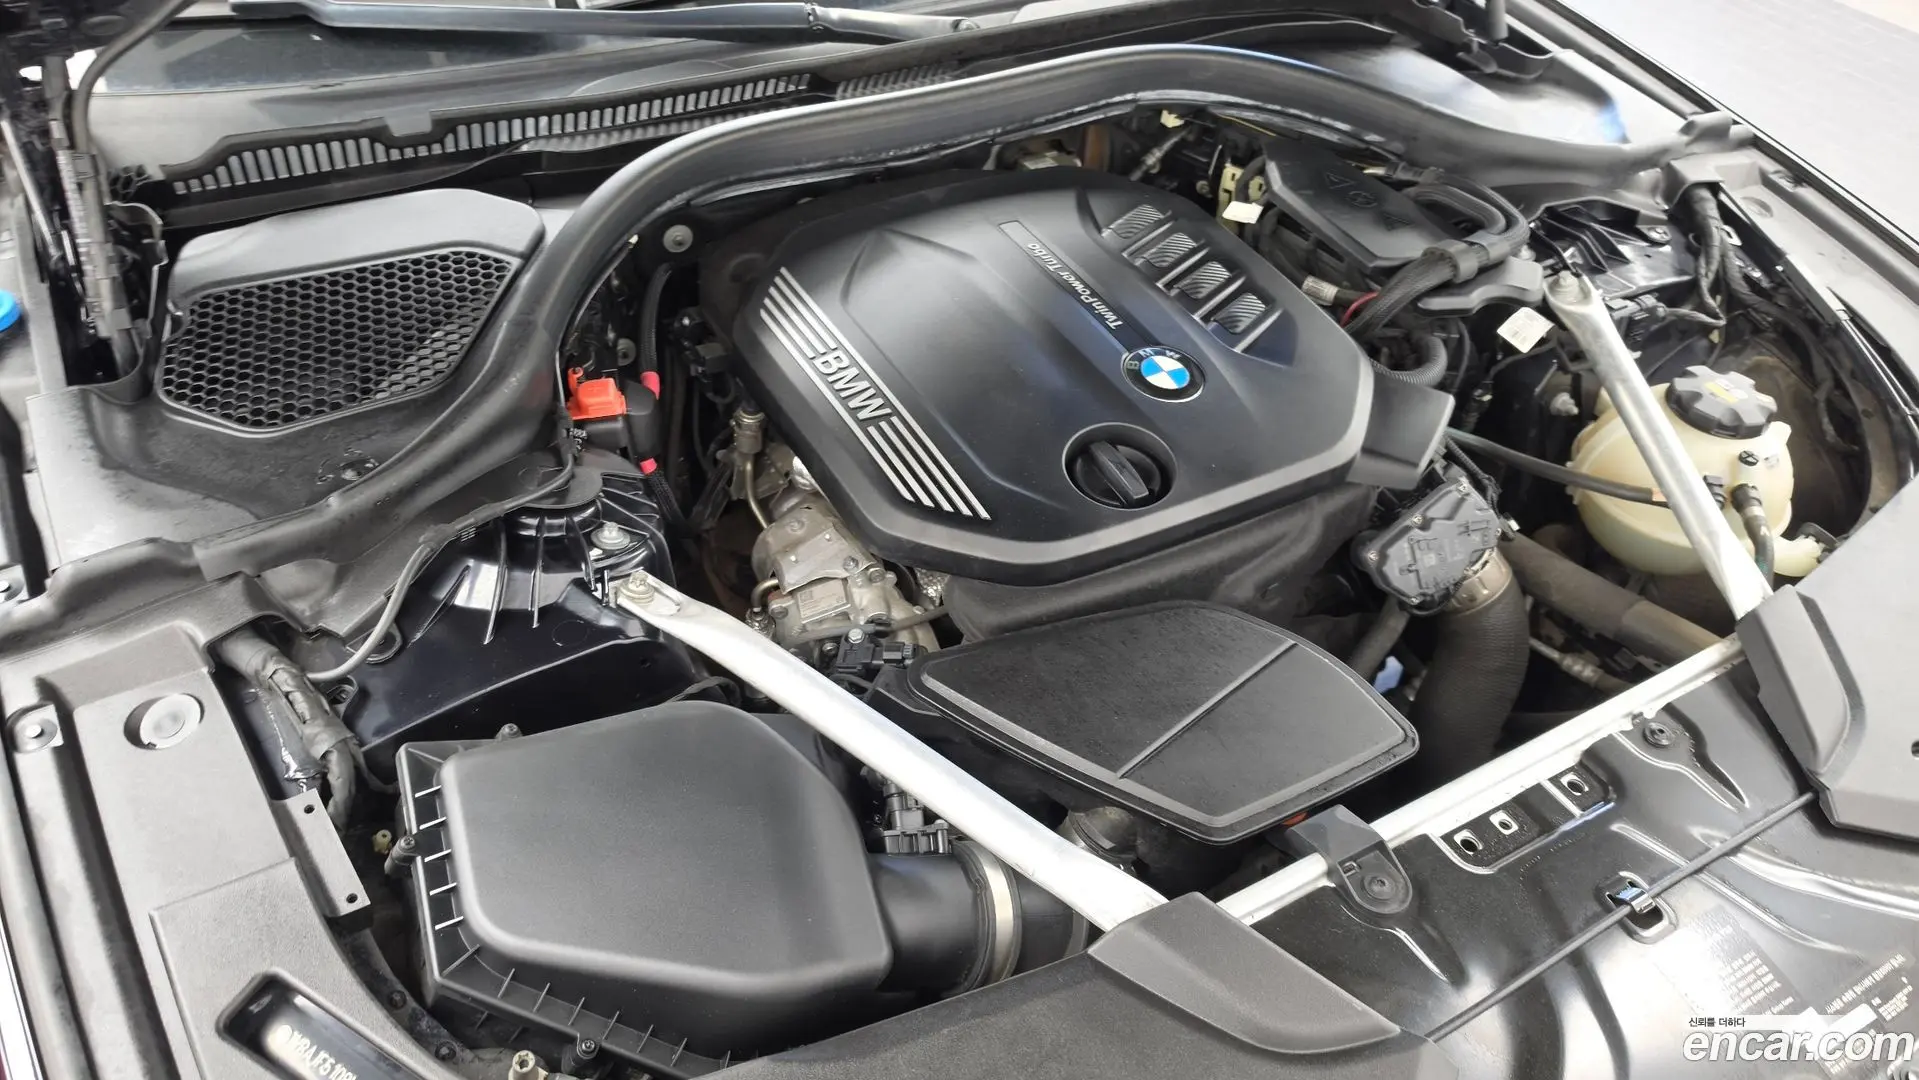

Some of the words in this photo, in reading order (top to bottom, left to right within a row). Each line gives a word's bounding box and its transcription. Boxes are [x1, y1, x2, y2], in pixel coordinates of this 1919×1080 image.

[1027, 242, 1063, 272] Turbo
[1059, 269, 1123, 331] TwinPower
[1126, 347, 1182, 370] BMW
[812, 348, 893, 421] BMW
